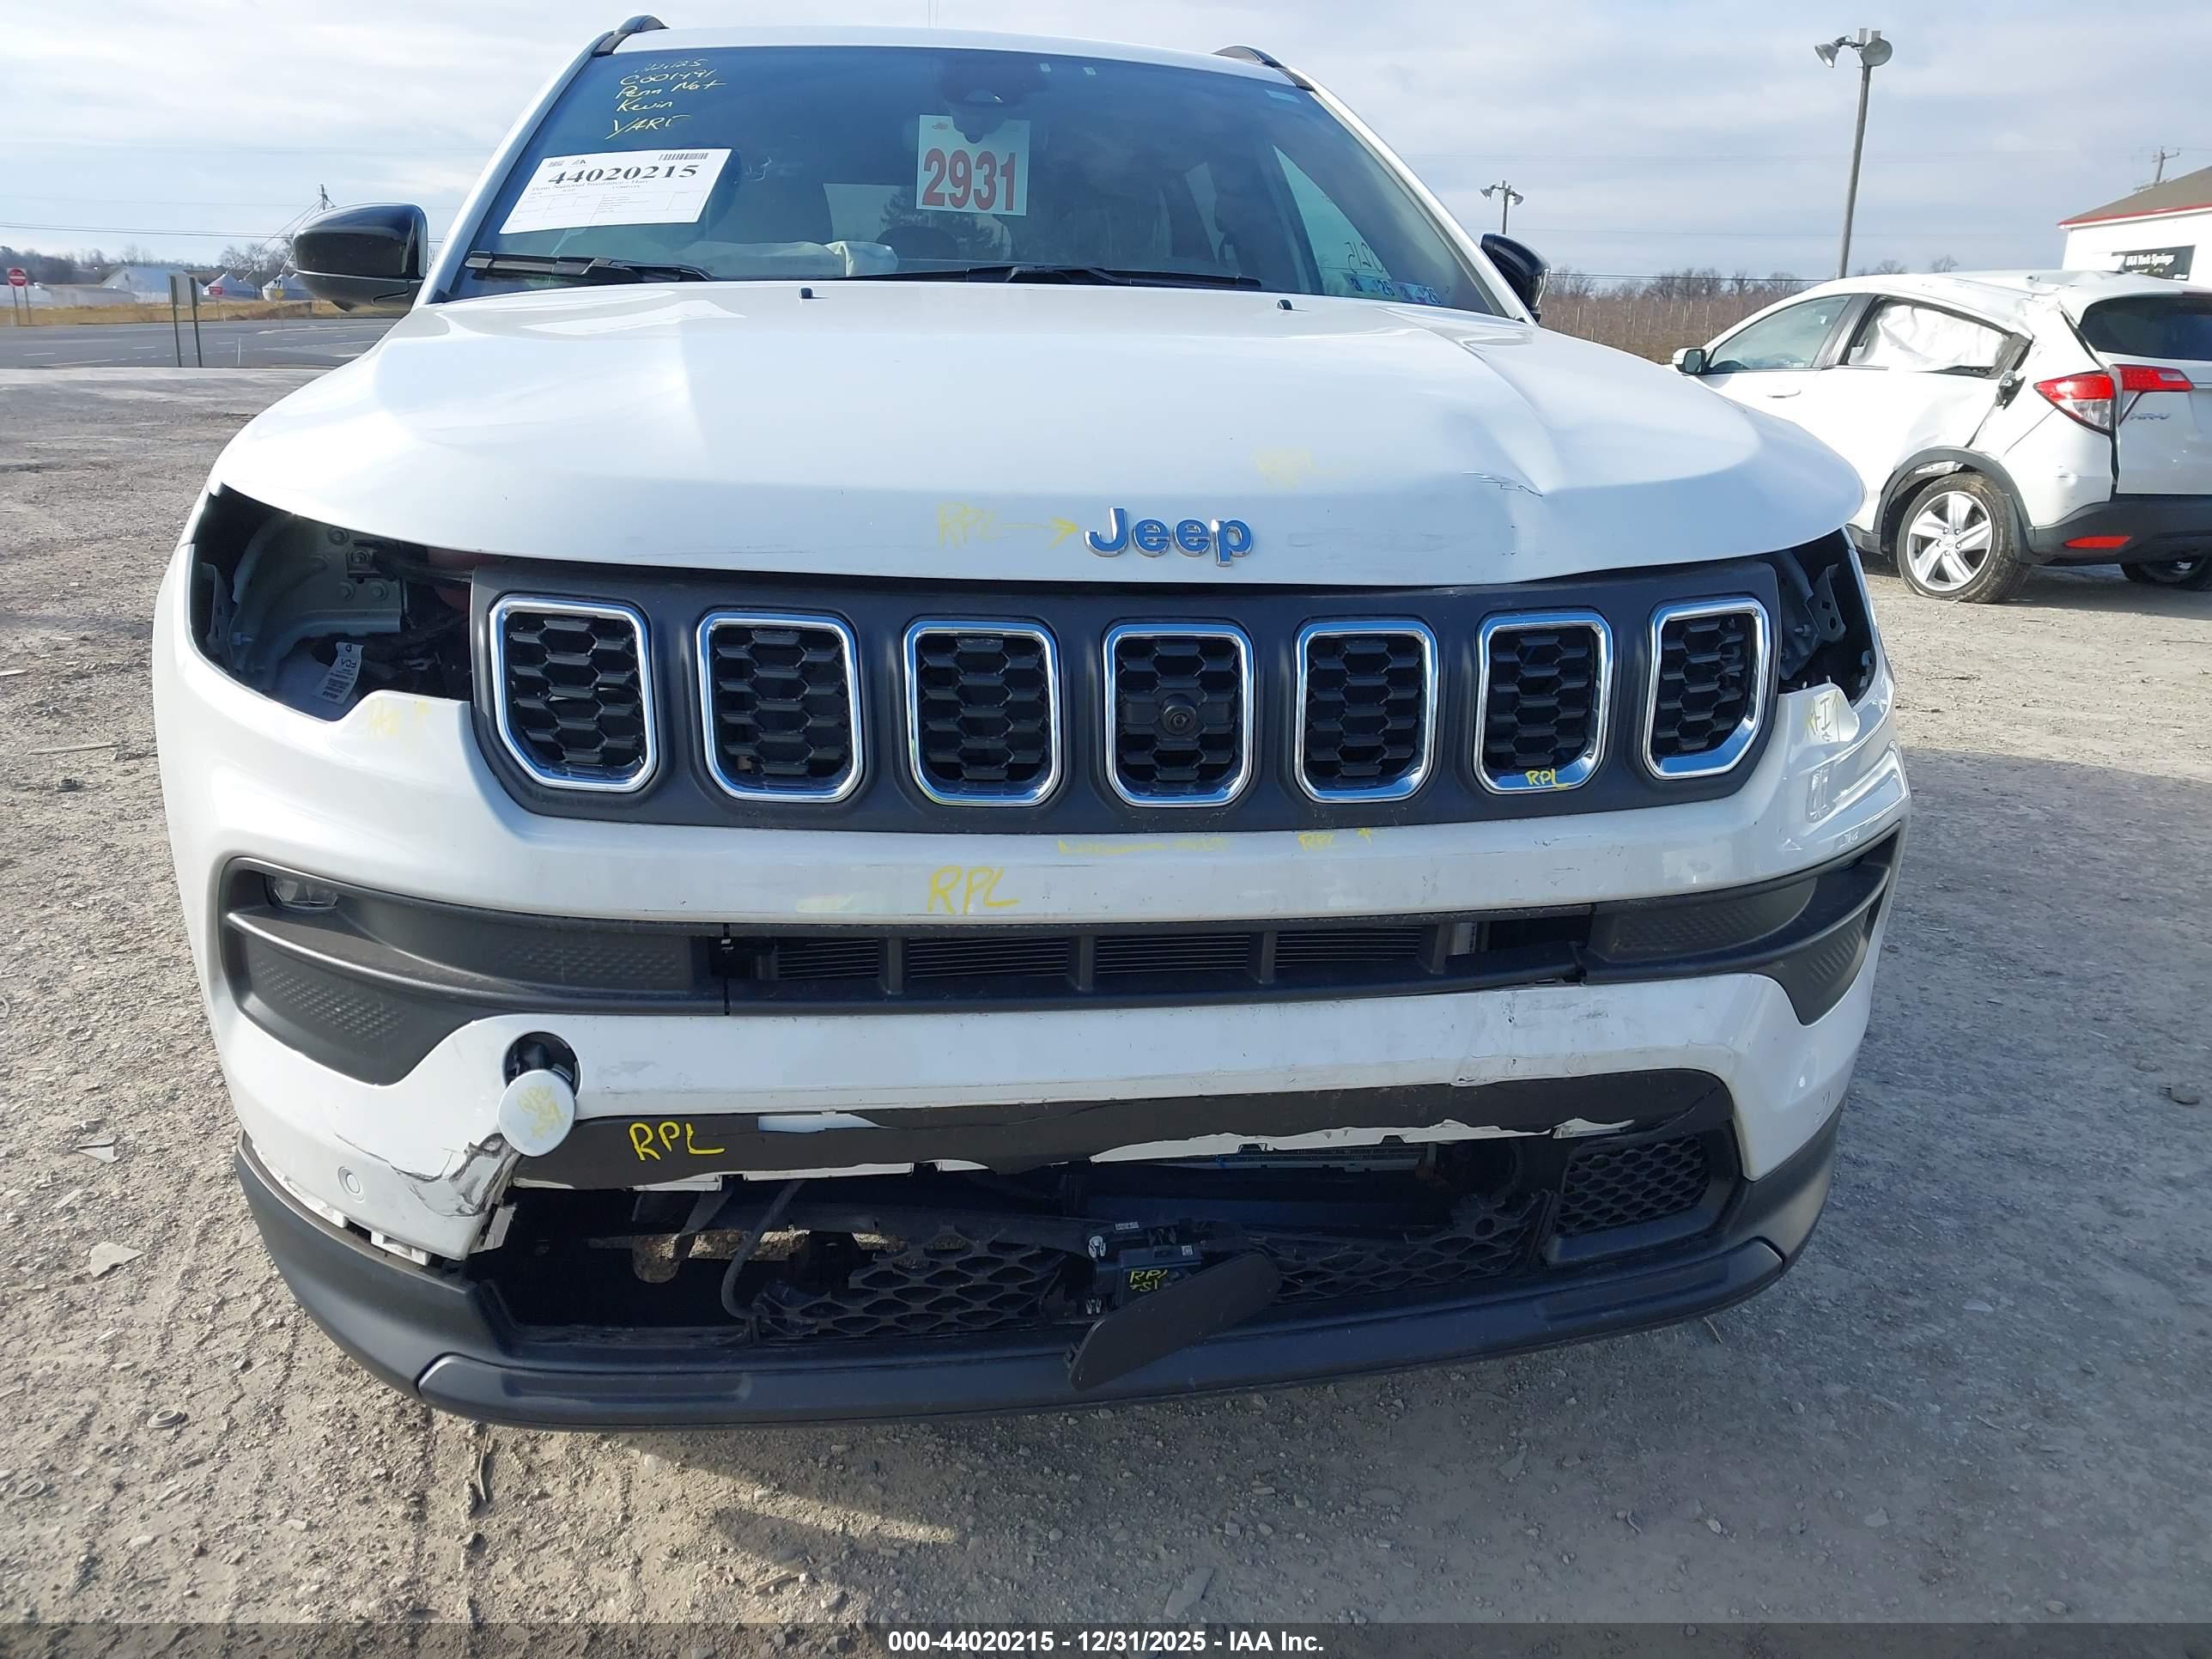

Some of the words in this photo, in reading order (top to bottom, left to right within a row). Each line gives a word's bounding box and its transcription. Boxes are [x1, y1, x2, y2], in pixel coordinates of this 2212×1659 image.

[615, 85, 663, 100] Penn
[616, 97, 673, 112] Kevin
[547, 164, 701, 185] 44020215
[921, 147, 1016, 211] 2931
[1085, 507, 1254, 567] Jeep
[1525, 768, 1571, 789] RPL
[927, 865, 1022, 915] RPL
[629, 1121, 726, 1161] RPL
